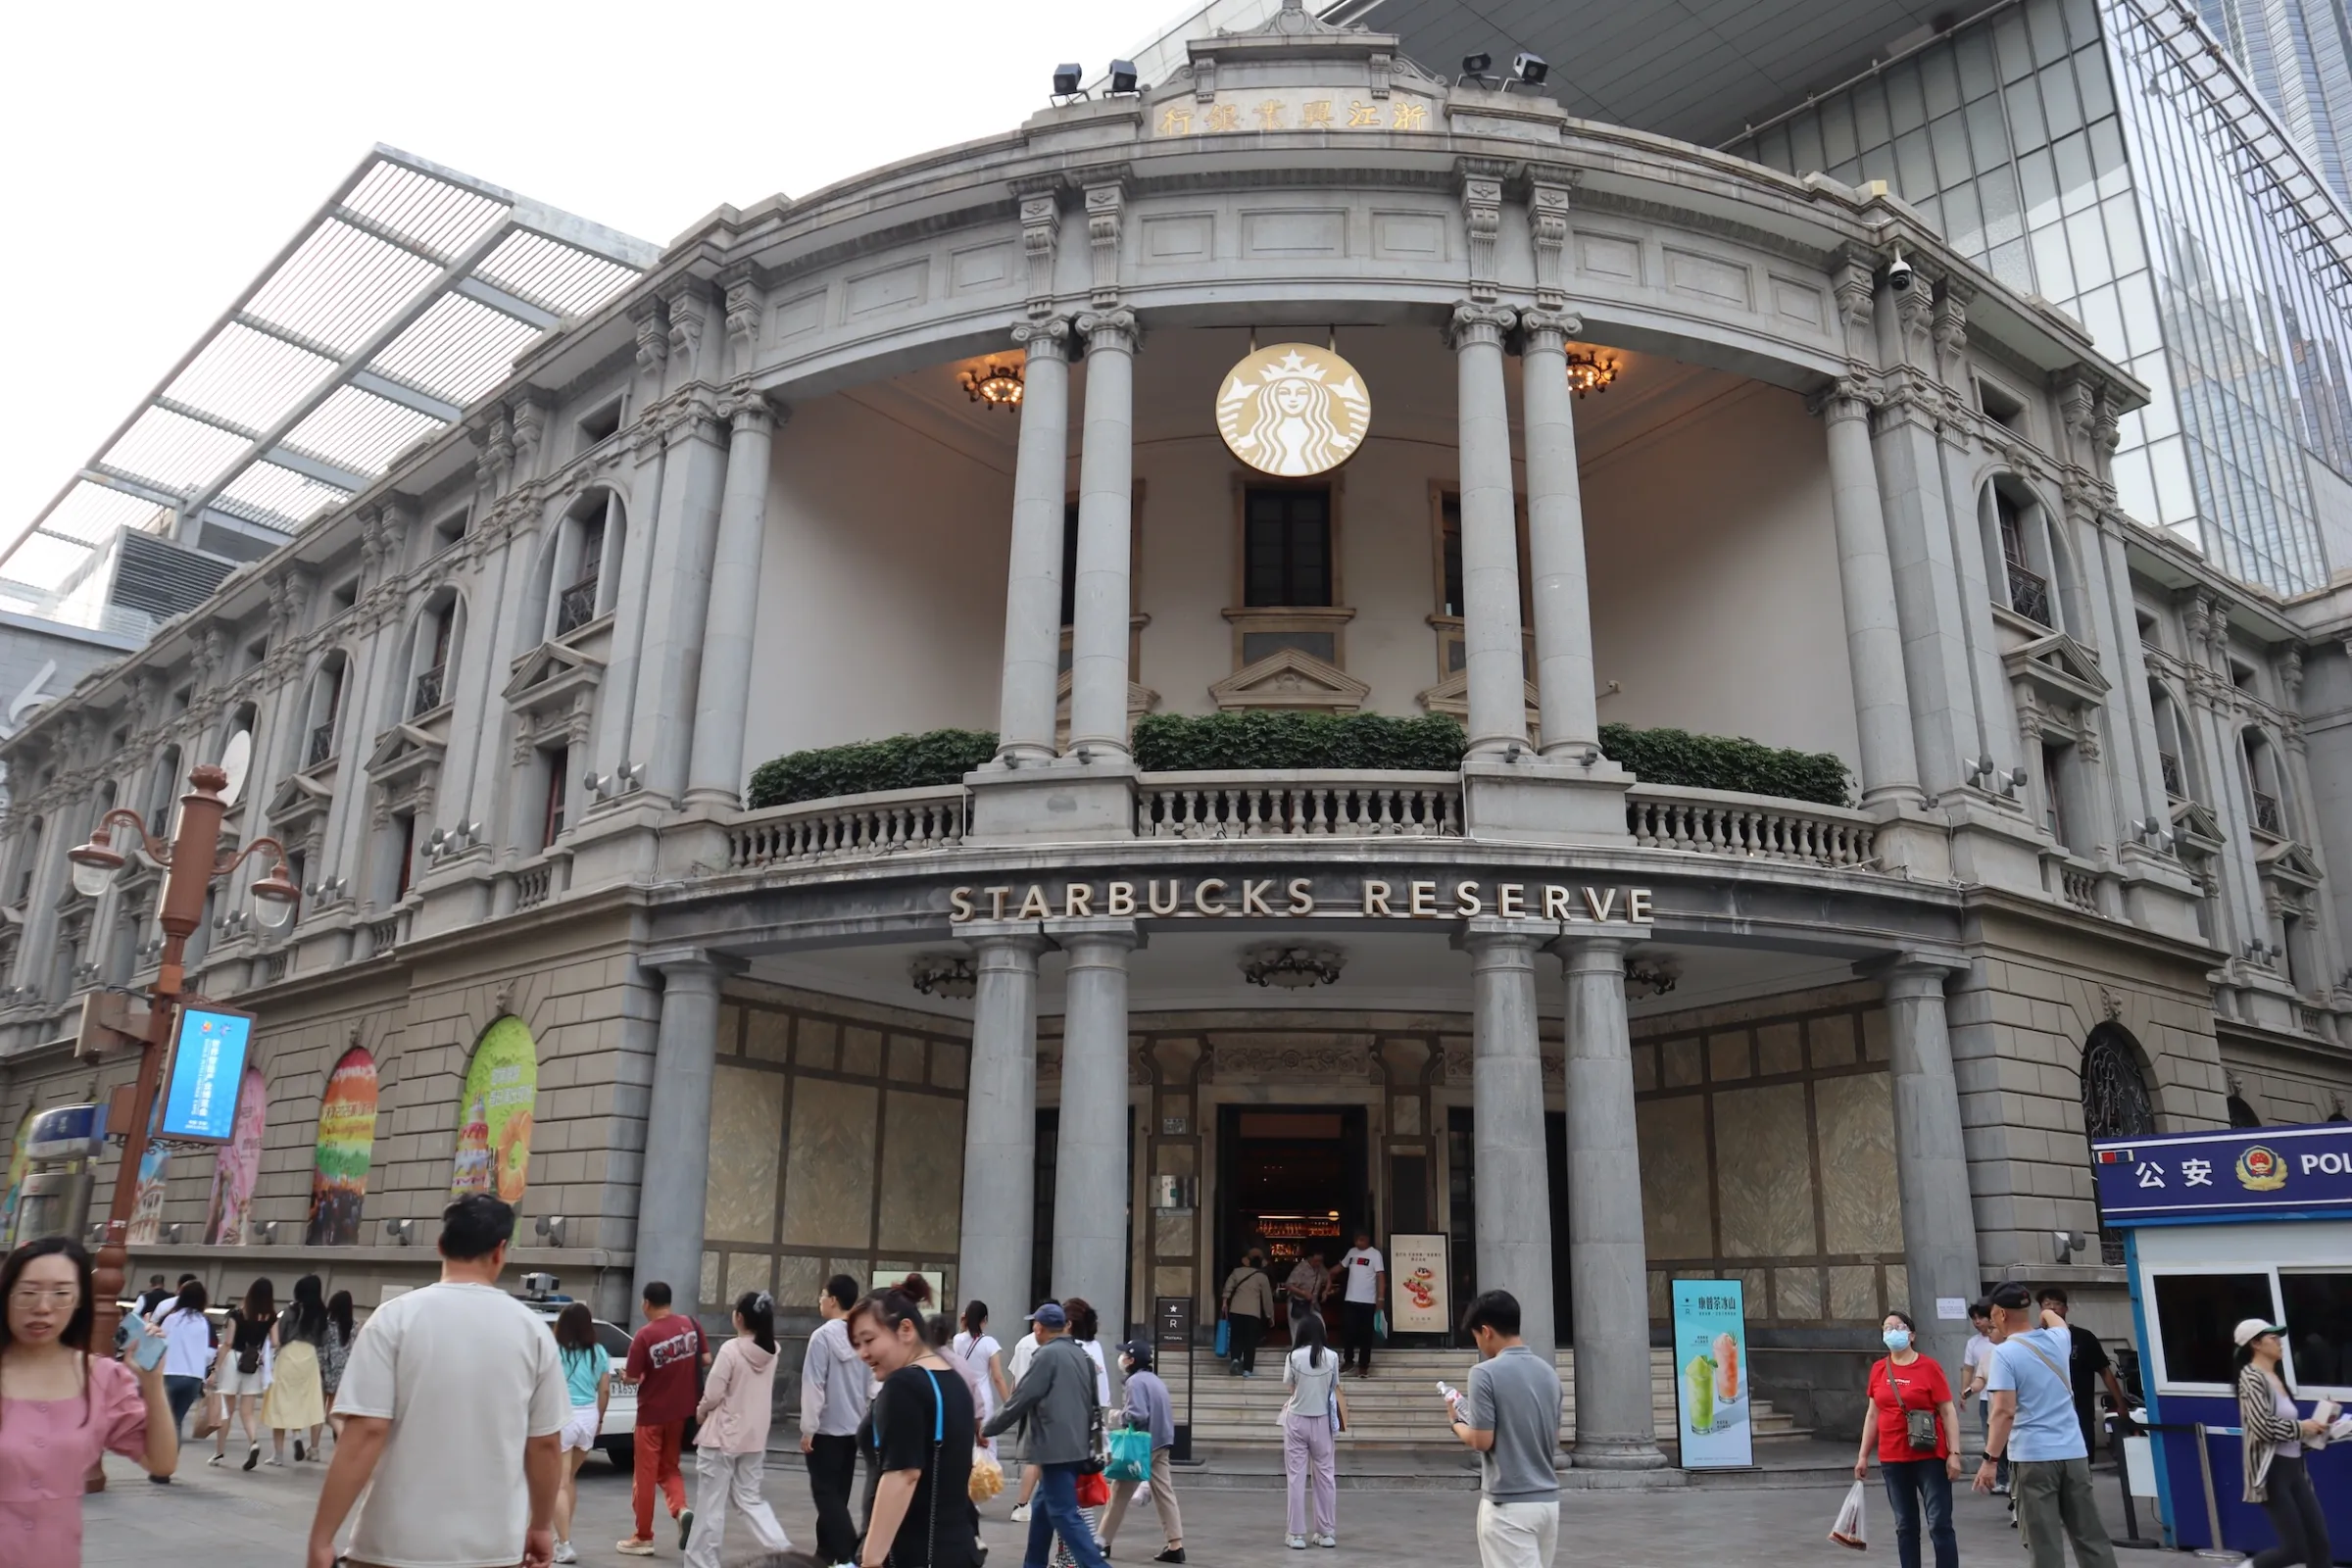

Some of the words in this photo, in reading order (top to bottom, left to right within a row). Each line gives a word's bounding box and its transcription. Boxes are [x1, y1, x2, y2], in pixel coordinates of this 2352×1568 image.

[949, 878, 1315, 922] STARBUCKS
[1363, 879, 1654, 924] RESERVE
[2135, 1158, 2213, 1189] 公安
[1169, 1318, 1178, 1328] R
